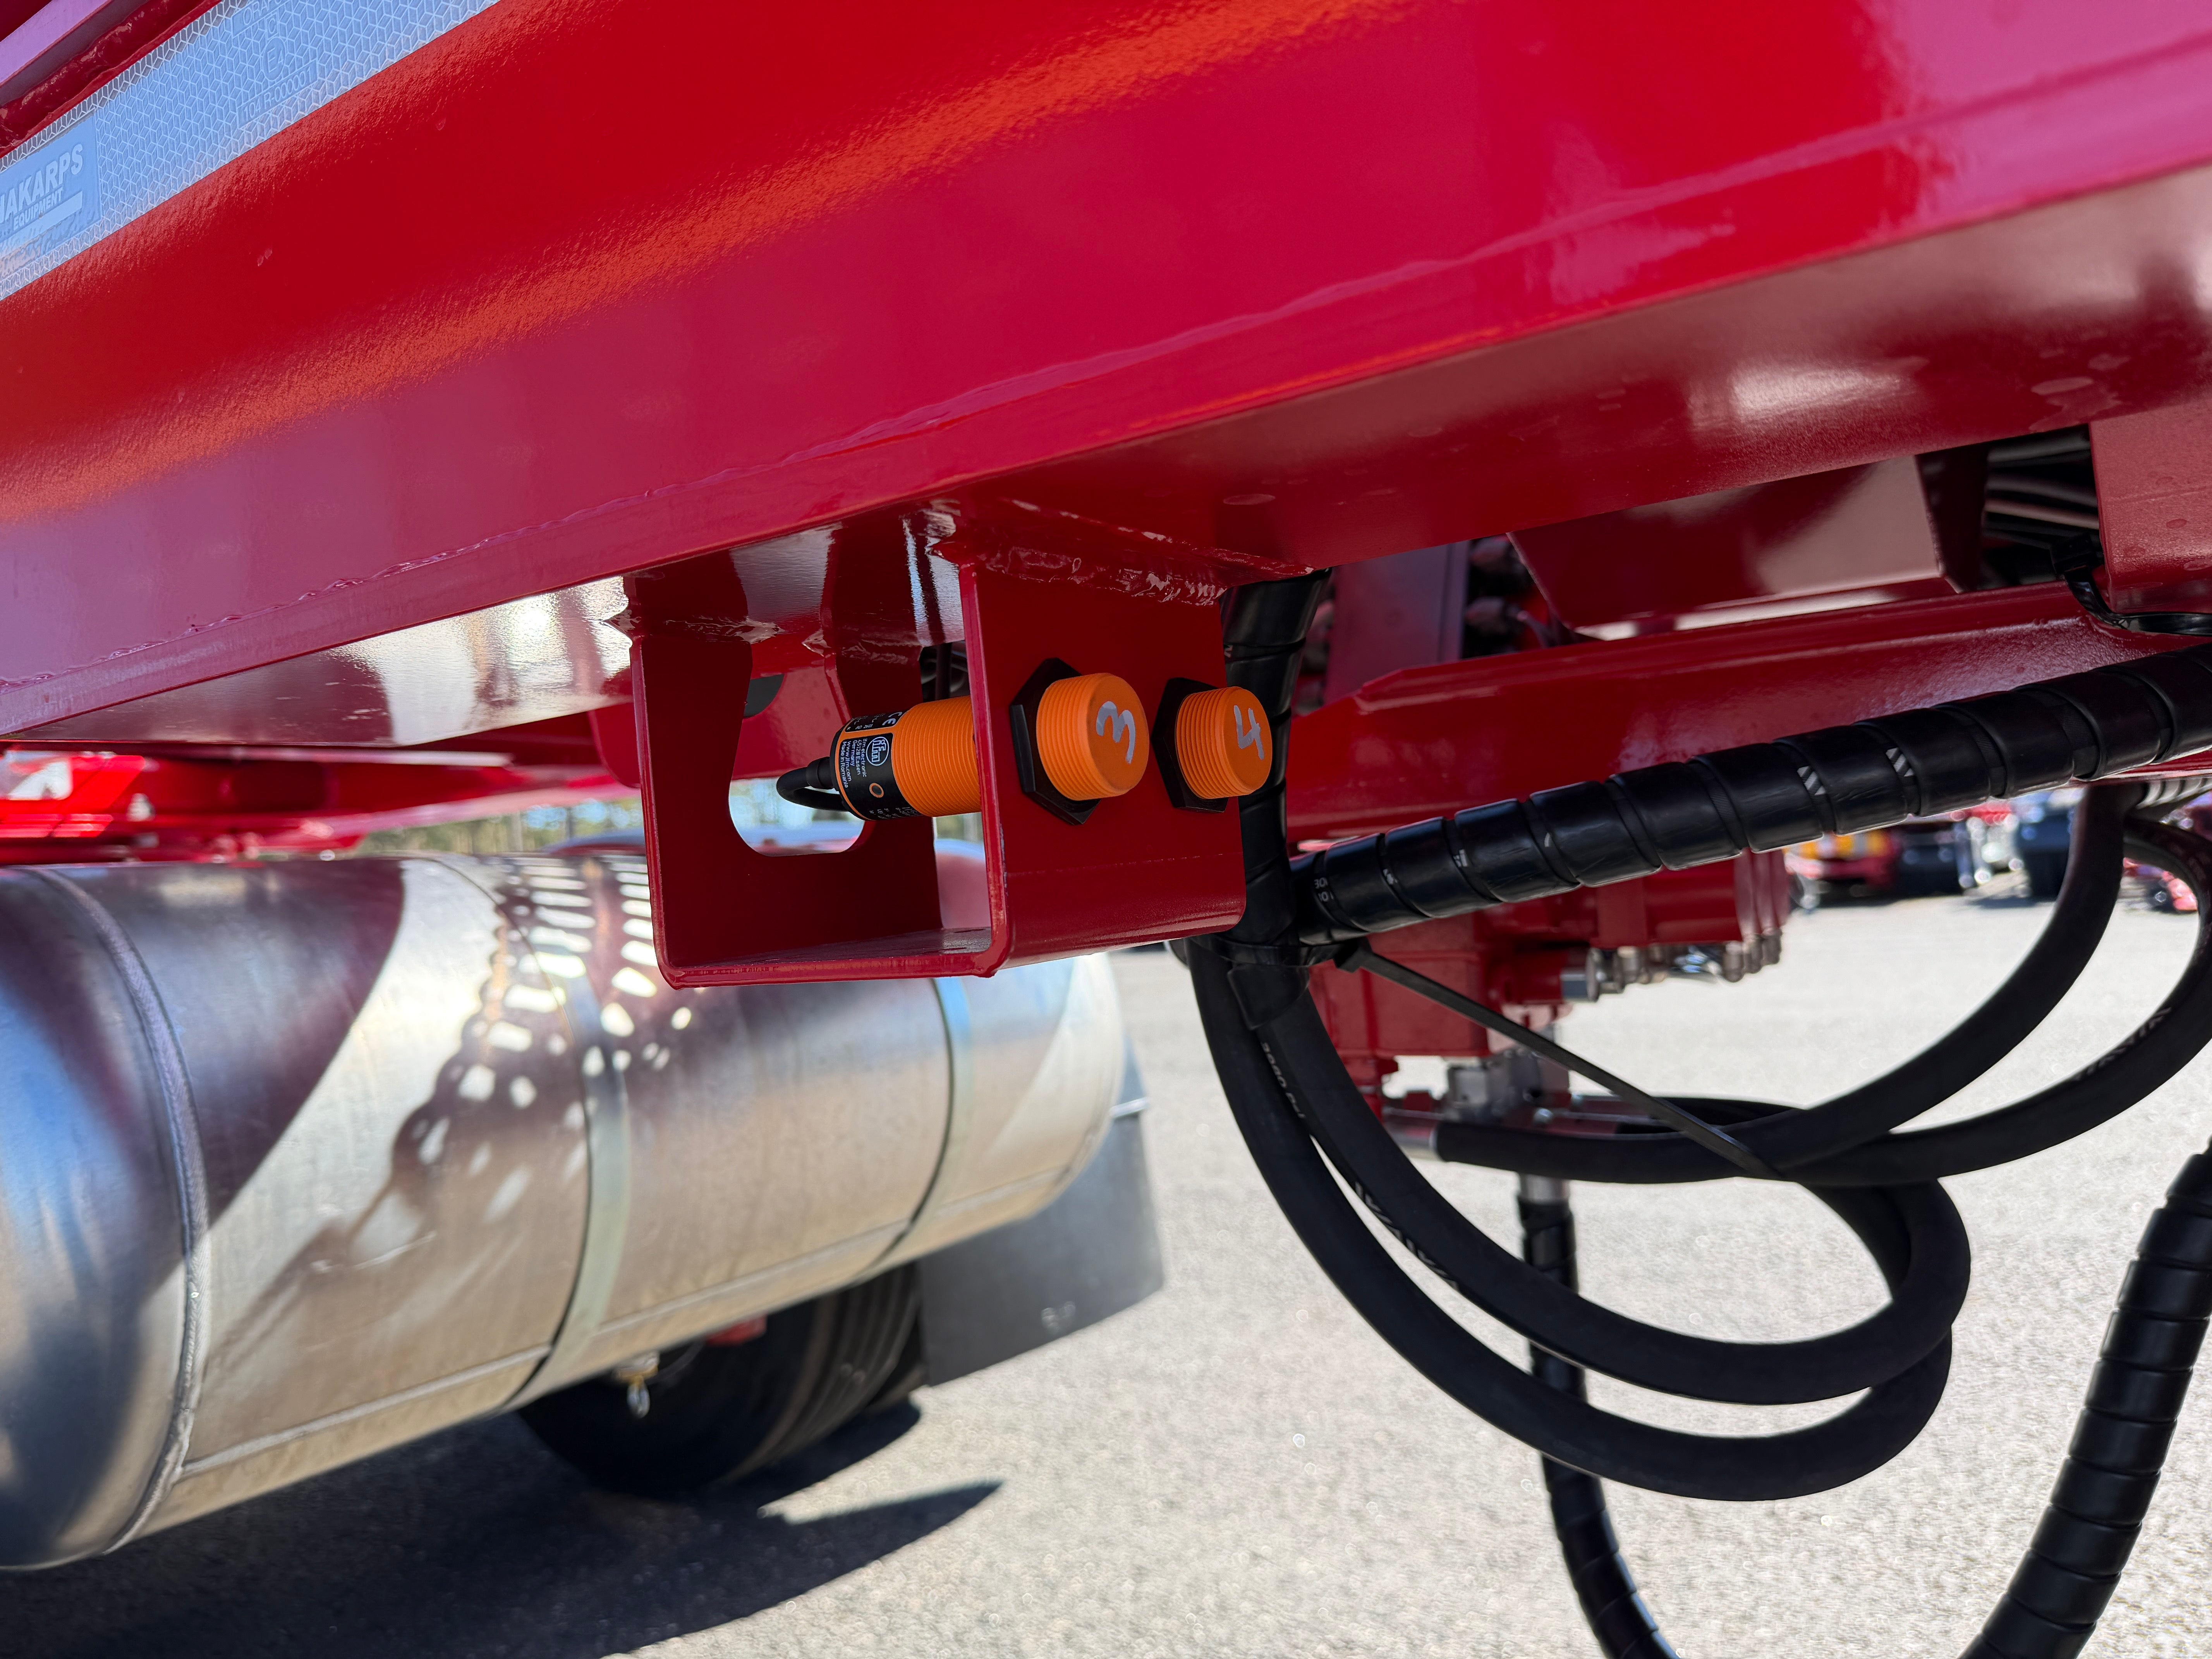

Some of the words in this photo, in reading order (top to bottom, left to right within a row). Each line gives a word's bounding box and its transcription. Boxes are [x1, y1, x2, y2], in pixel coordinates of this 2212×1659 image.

[243, 0, 282, 26] ORAF
[267, 47, 284, 73] E4
[244, 98, 261, 122] 104
[264, 65, 313, 109] R-000001
[14, 186, 63, 231] EQUIPMENT
[1096, 700, 1136, 765] 3
[1233, 704, 1264, 761] 4
